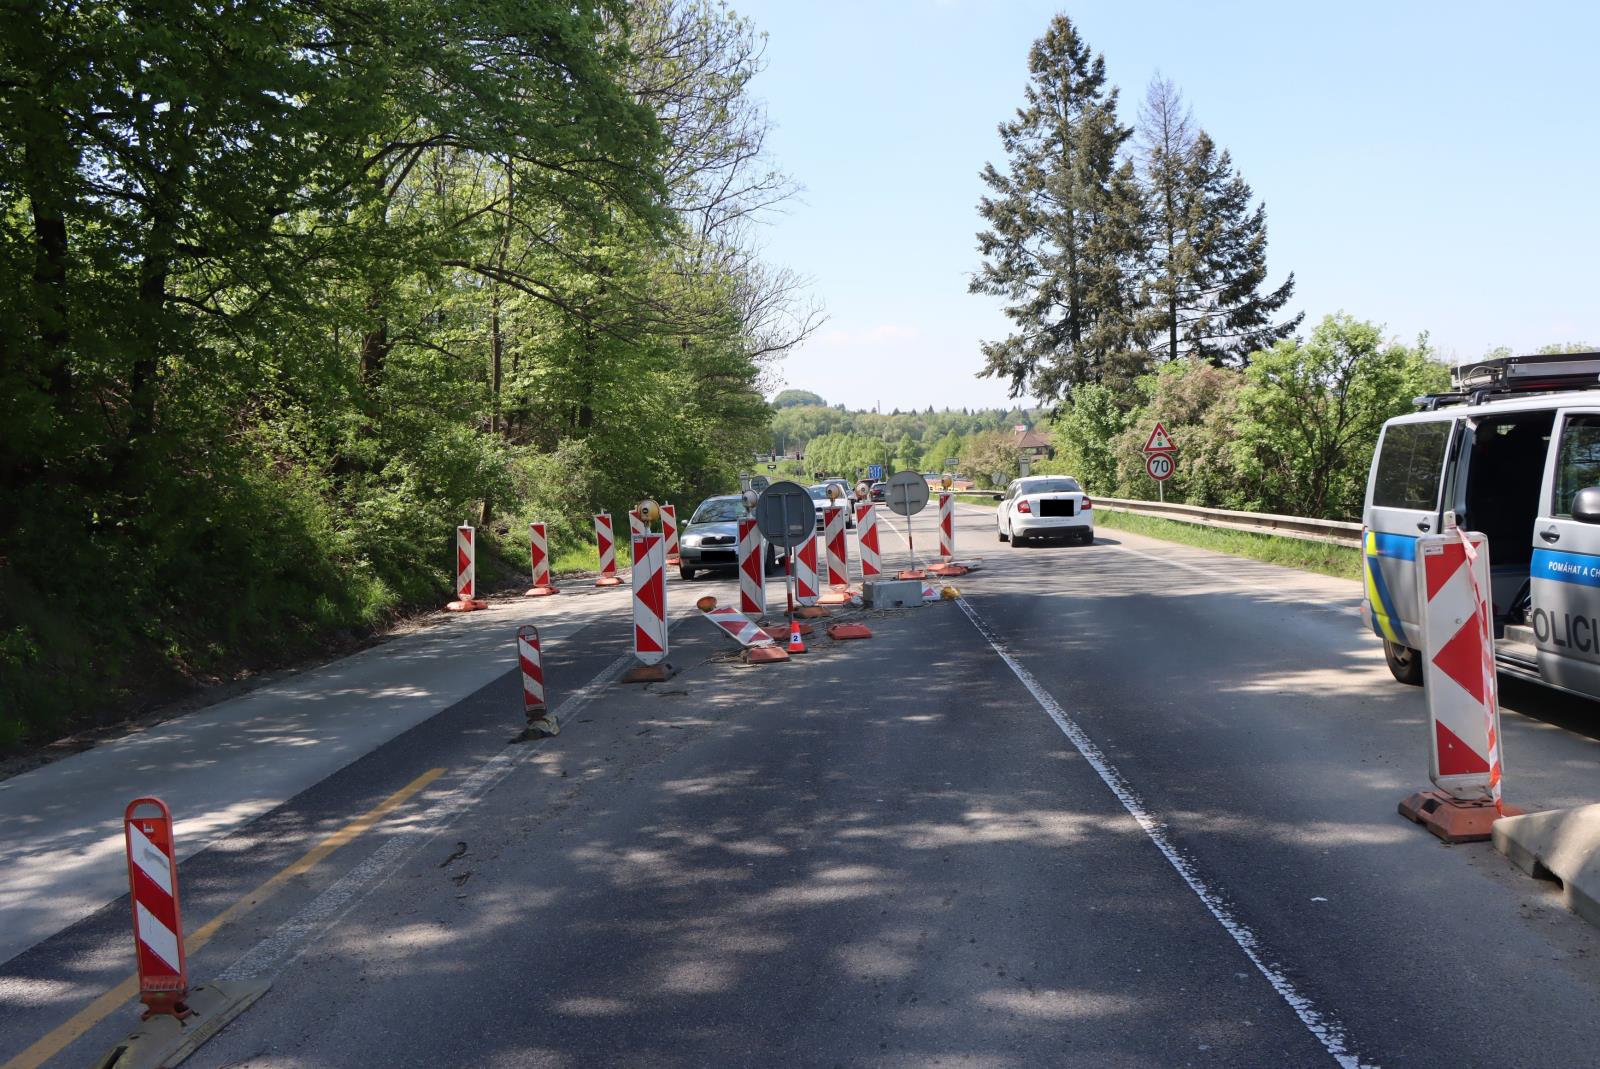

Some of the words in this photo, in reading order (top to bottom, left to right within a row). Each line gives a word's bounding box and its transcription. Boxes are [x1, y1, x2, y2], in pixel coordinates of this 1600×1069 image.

[1152, 460, 1169, 473] 70
[1548, 561, 1582, 575] POMÁHAT
[1582, 567, 1588, 577] A
